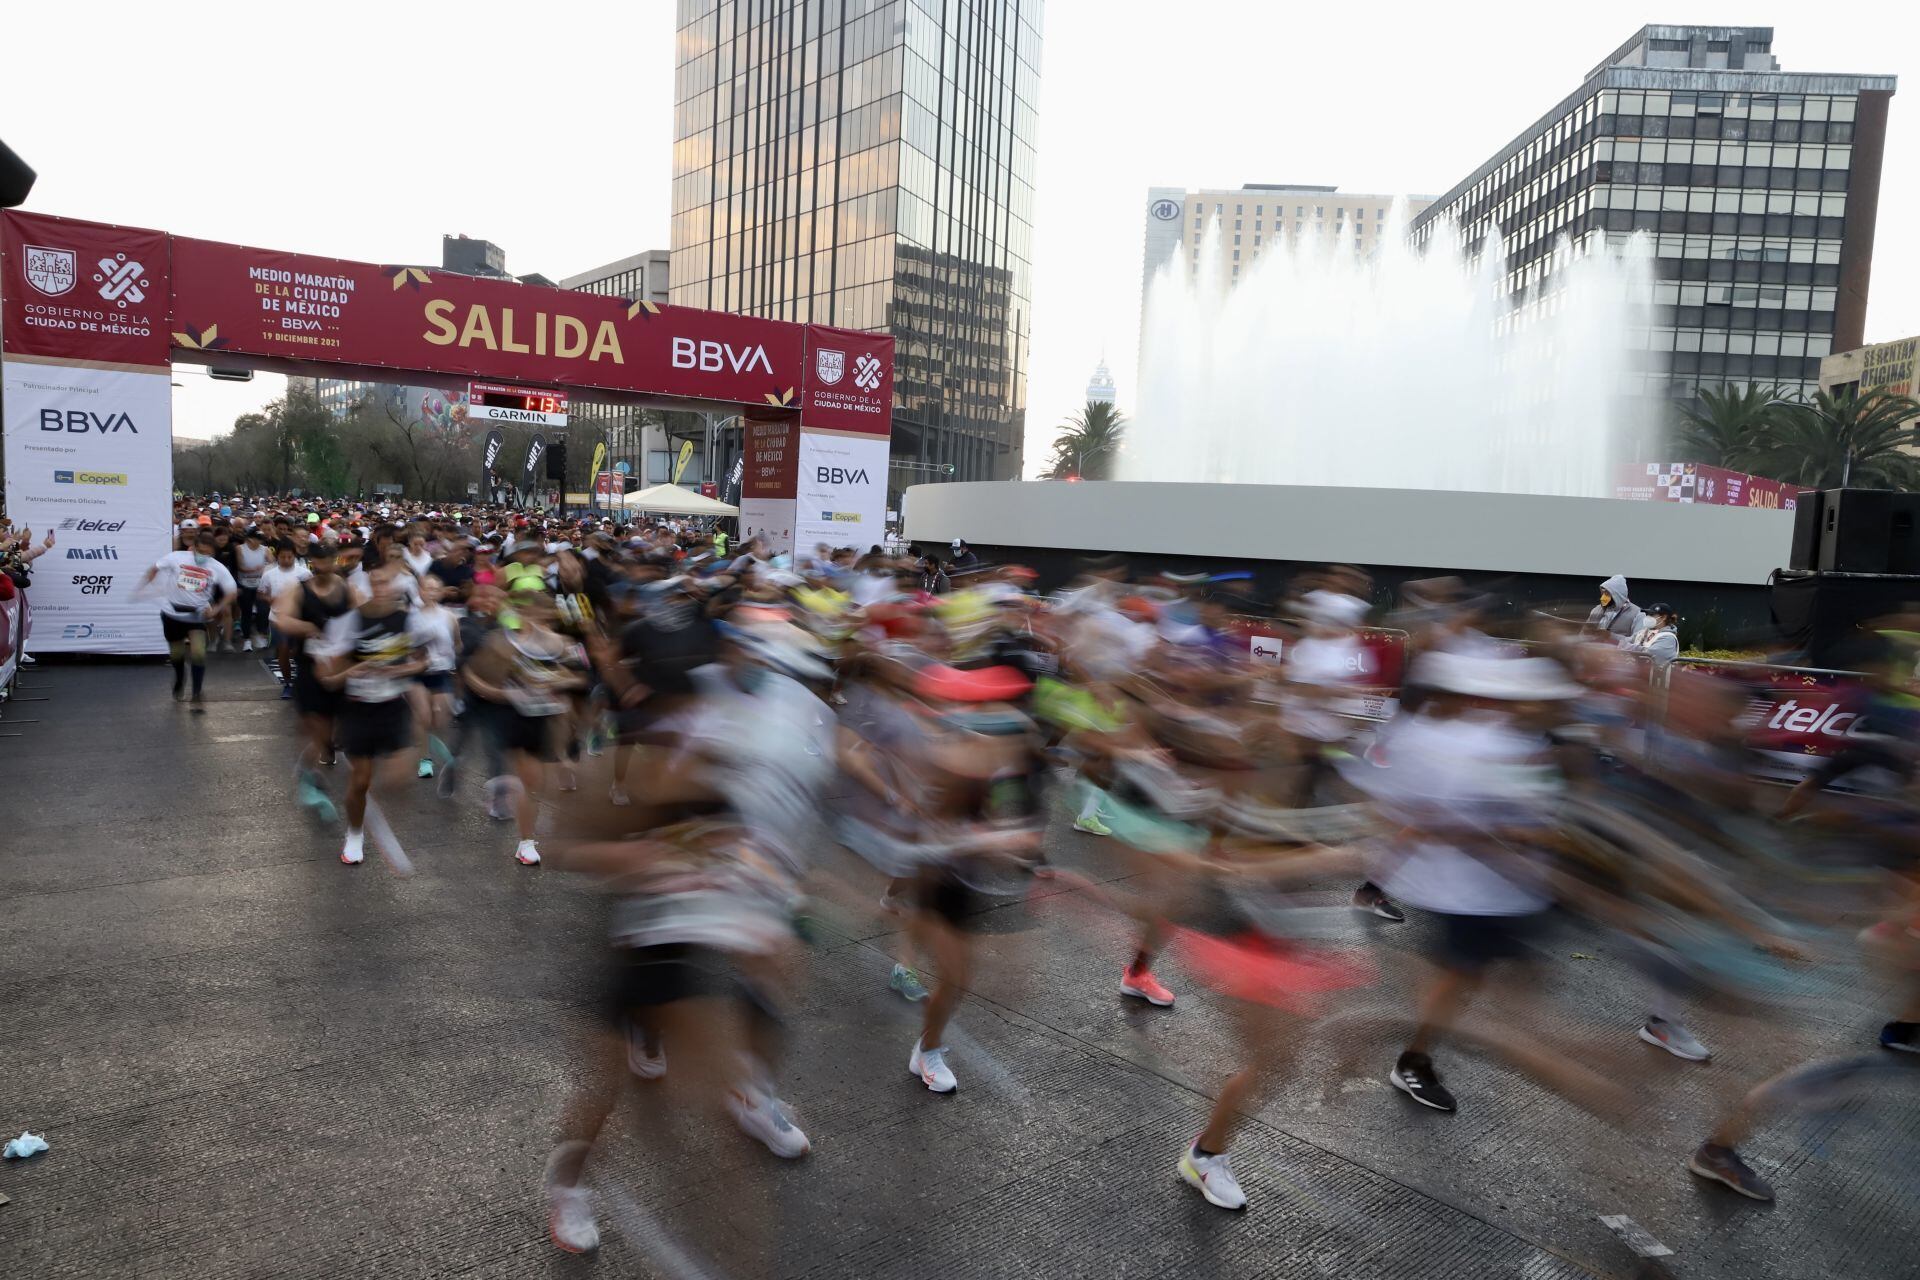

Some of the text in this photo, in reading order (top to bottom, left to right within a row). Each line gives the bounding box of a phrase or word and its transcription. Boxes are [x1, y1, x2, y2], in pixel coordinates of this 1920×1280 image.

[249, 267, 355, 291] MEDIO MARATÓN
[255, 282, 348, 304] DE LA CIUDAD
[25, 304, 150, 325] GOBIERNO DE LA
[262, 298, 340, 318] DE MÉXICO
[25, 316, 150, 336] CIUDAD DE MÉXICO
[281, 317, 323, 331] BBVA
[422, 299, 625, 365] SALIDA
[262, 331, 340, 347] 19 DICIEMBRE 2021
[672, 336, 774, 375] BBVA
[1860, 360, 1913, 388] OFICINAS
[23, 382, 99, 396] Patrocinador Principal
[814, 391, 857, 402] GOBIERNO
[859, 396, 869, 404] DE
[814, 399, 881, 413] CIUDAD DE MÉXICO
[40, 408, 138, 434] BBVA
[488, 408, 547, 422] GARMIN
[24, 444, 63, 453] Presentado
[766, 437, 787, 448] CIUDAD
[484, 438, 499, 469] SHIFT
[526, 441, 542, 472] SHIFT
[756, 451, 763, 462] DE
[80, 473, 123, 485] Coppel
[731, 457, 744, 485] SHIFT
[817, 466, 870, 485] BBVA
[25, 495, 76, 504] Patrocinadores
[1748, 487, 1778, 509] SALIDA
[76, 518, 126, 532] telcel
[835, 513, 858, 522] Coppel
[71, 575, 113, 585] SPORT
[81, 585, 111, 595] CITY
